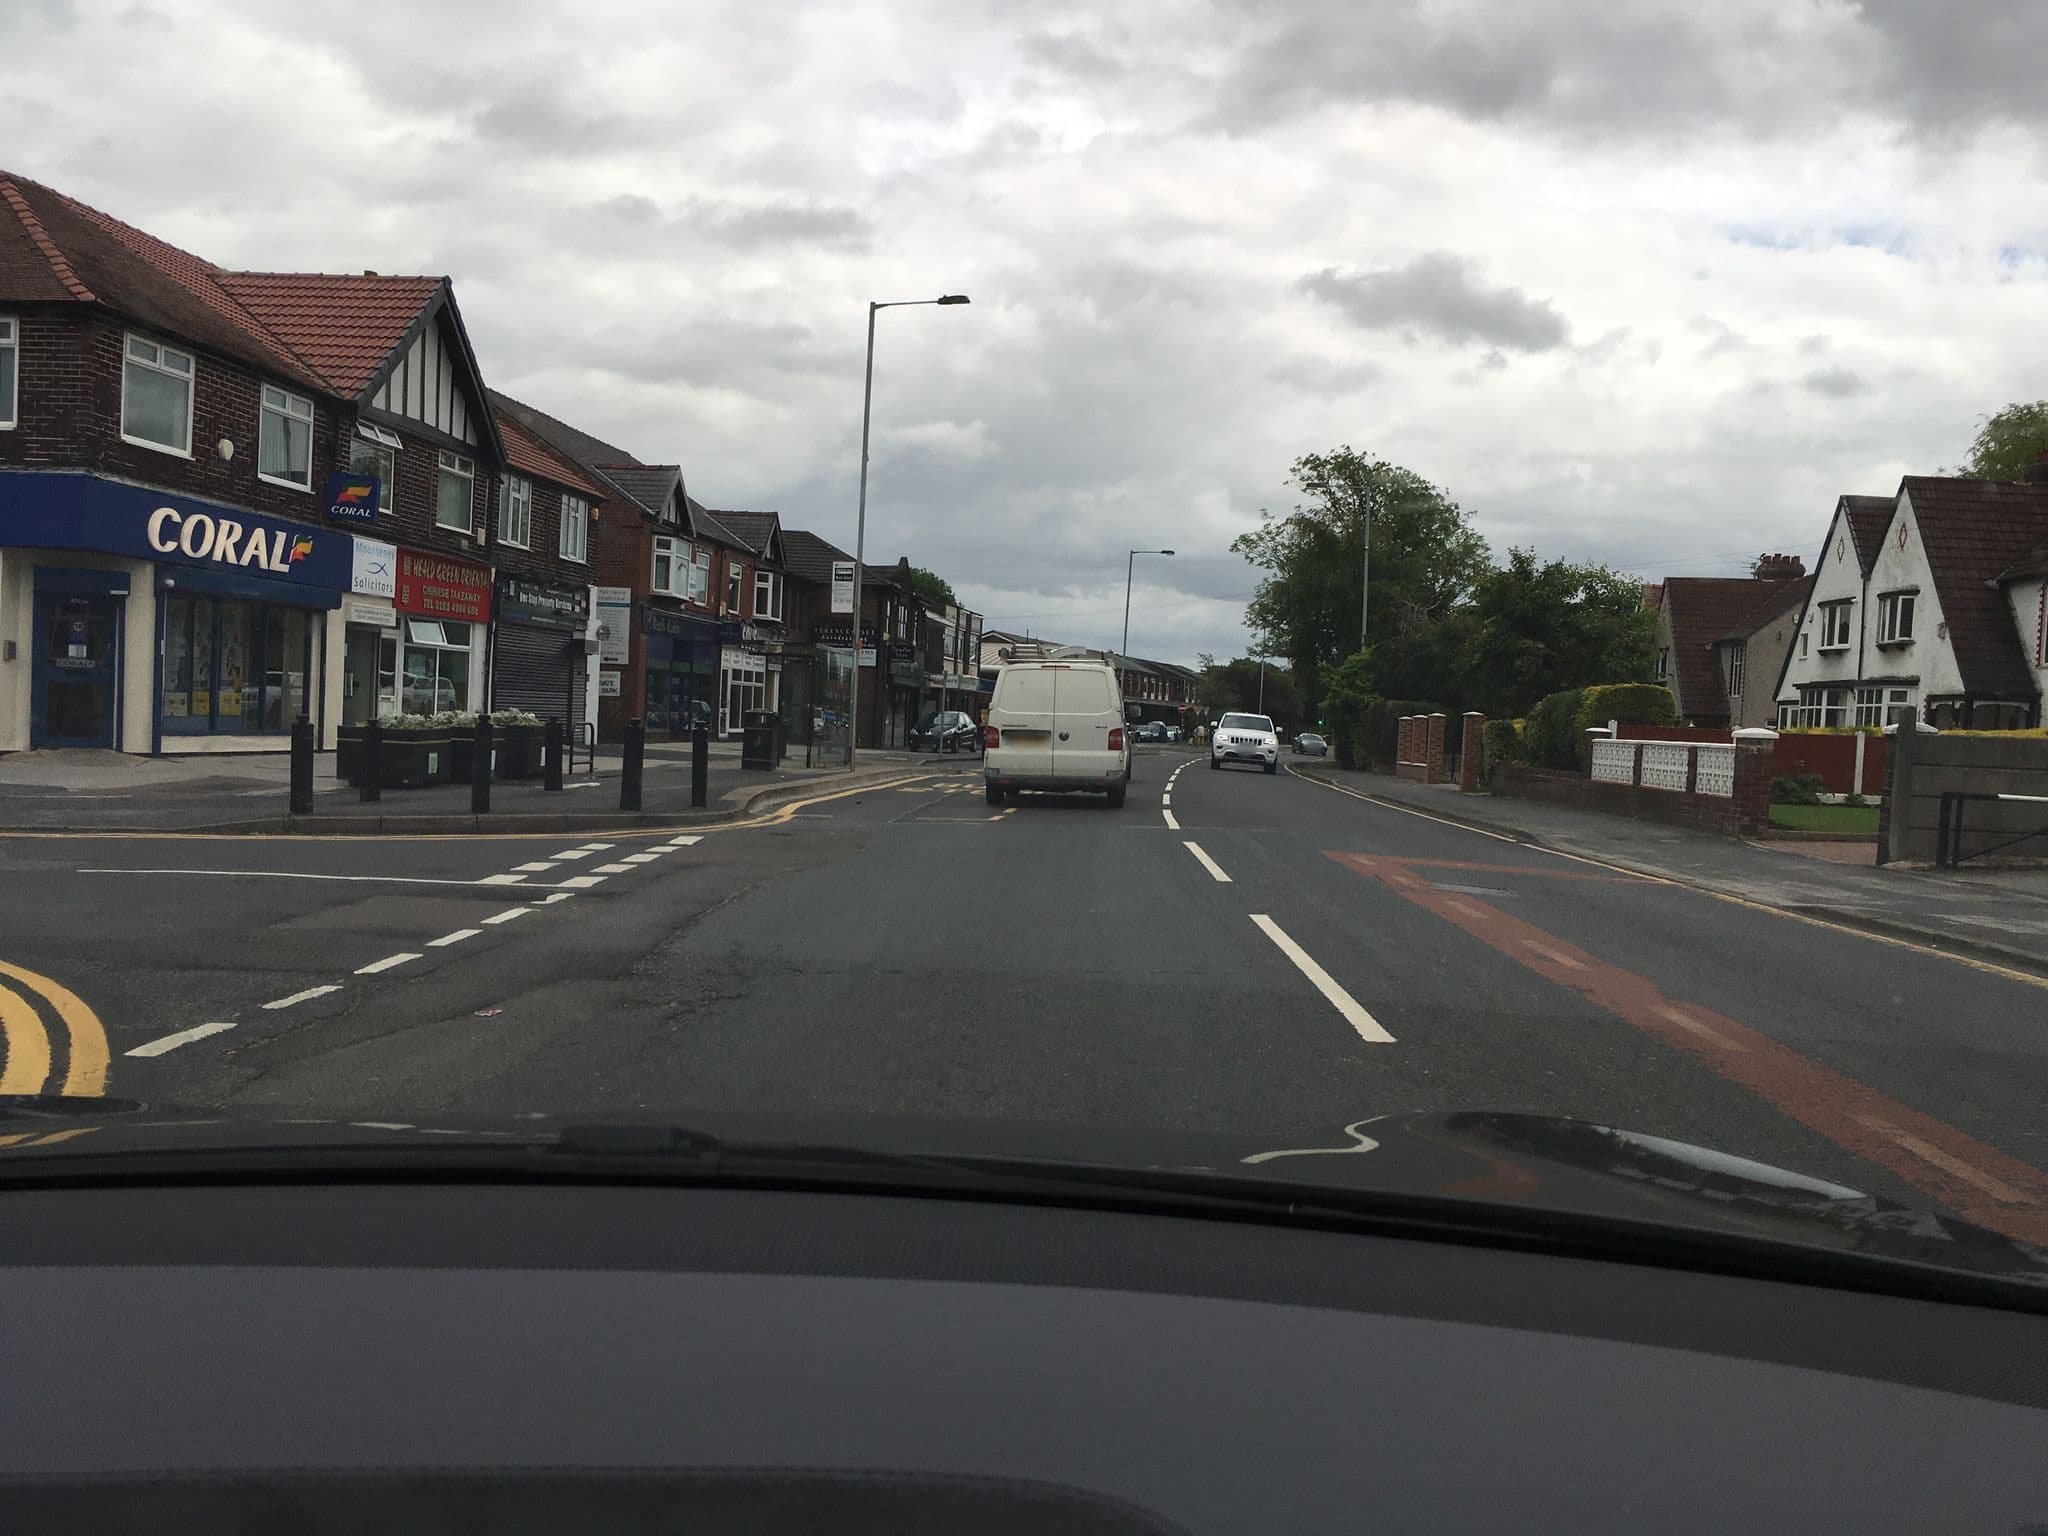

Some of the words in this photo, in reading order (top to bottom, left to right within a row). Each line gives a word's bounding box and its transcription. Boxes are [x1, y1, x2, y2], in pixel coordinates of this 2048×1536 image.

[331, 505, 372, 517] CORAL
[147, 507, 291, 573] CORAL
[413, 559, 435, 579] HEALD
[436, 562, 460, 584] GREEN
[353, 577, 393, 593] Solicitors
[422, 585, 450, 598] CHINESE
[450, 589, 480, 603] TAKEAWAY
[423, 598, 434, 610] TEL
